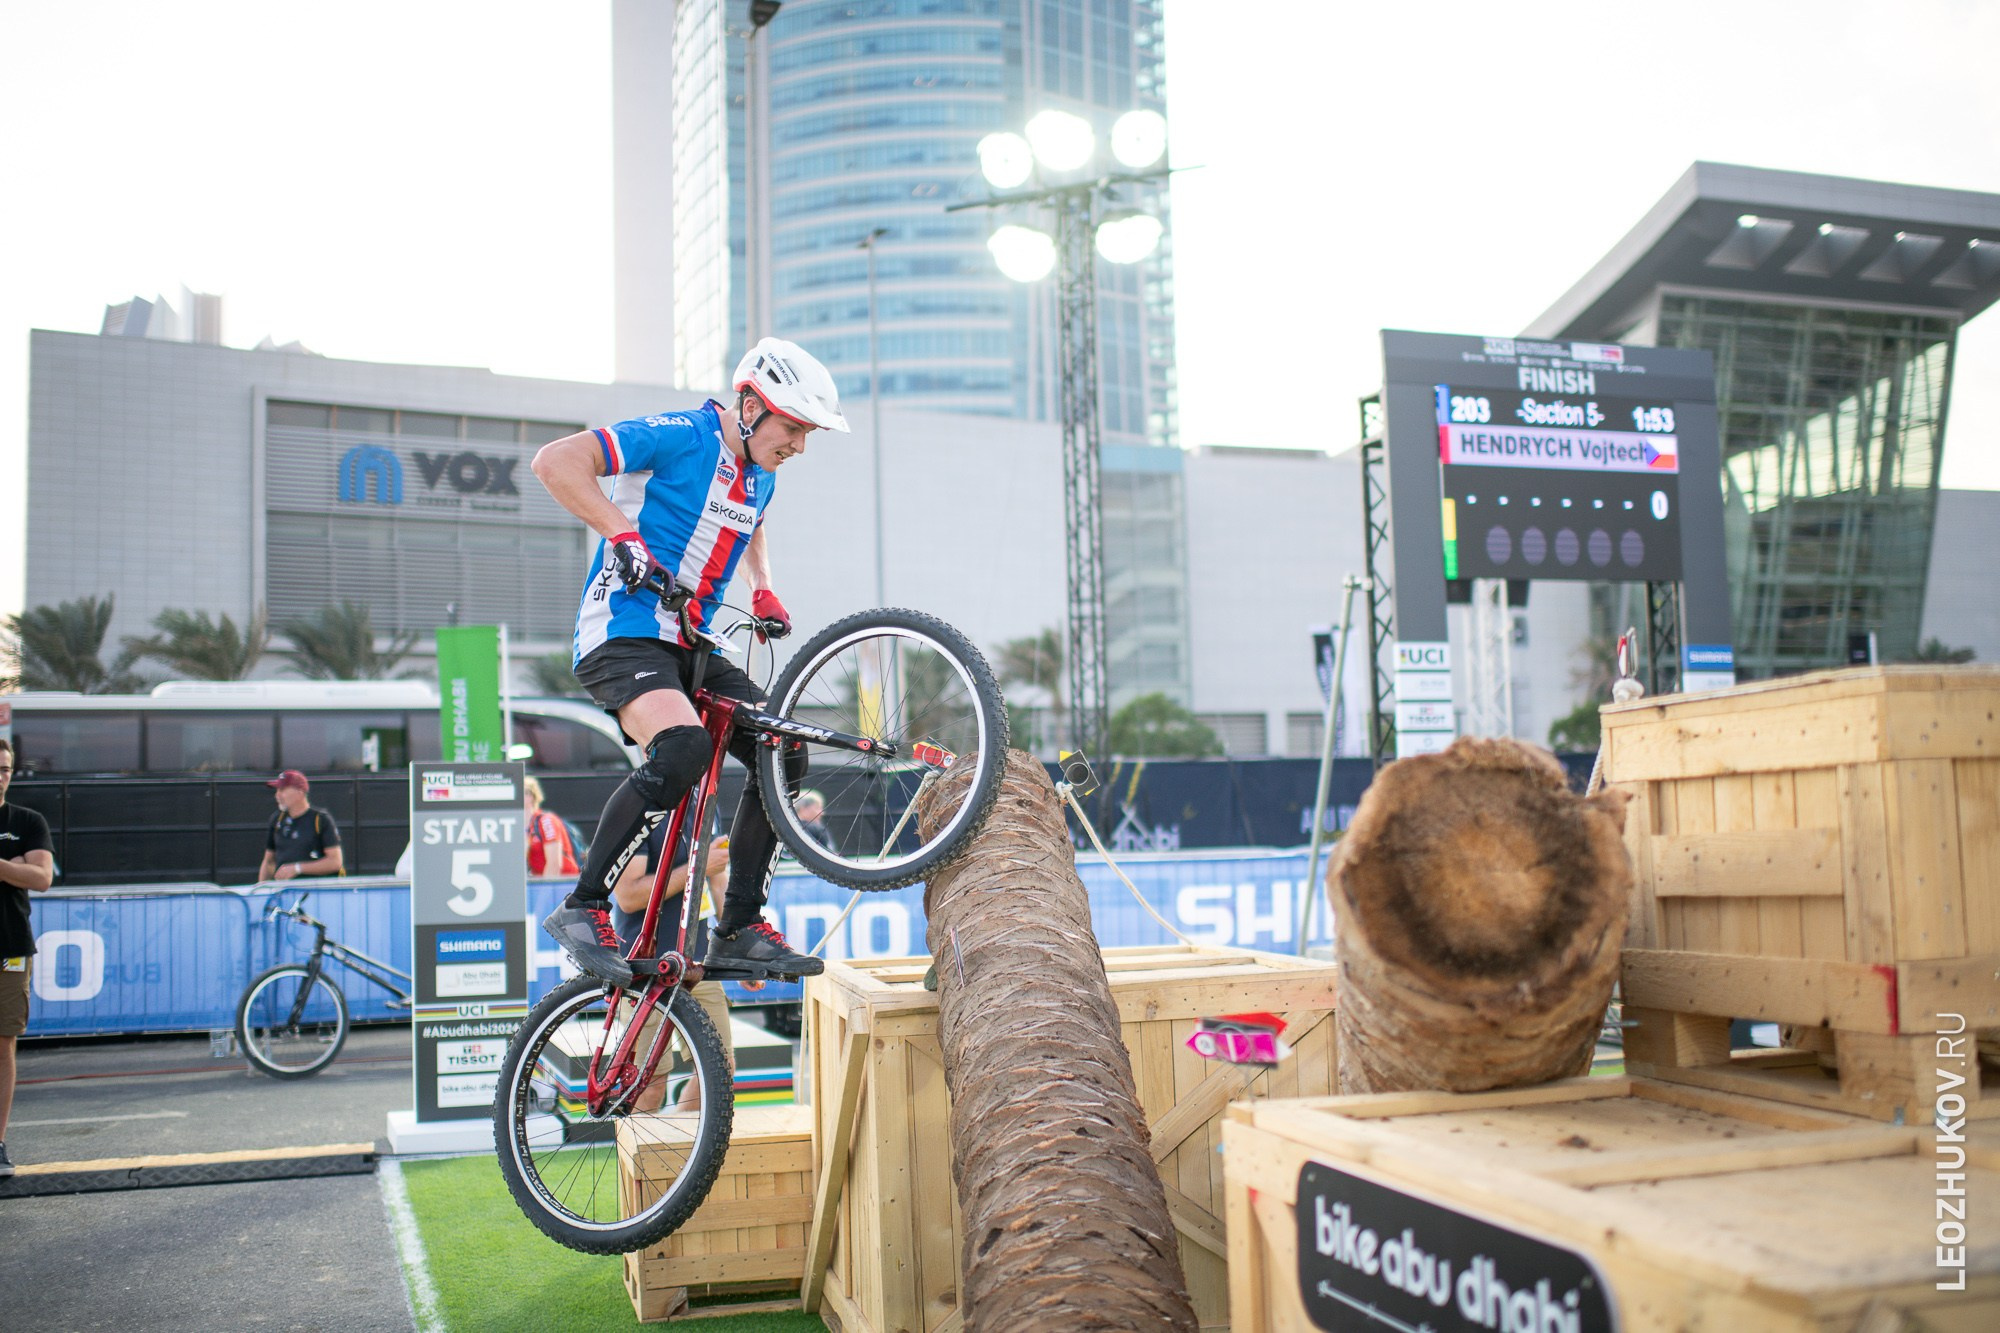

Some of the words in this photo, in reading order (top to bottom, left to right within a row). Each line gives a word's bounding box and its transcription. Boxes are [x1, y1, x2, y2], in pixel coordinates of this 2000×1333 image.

[1518, 367, 1596, 395] FINISH
[1451, 396, 1491, 423] 203
[1632, 406, 1675, 433] 1:53
[1461, 433, 1572, 457] HENDRYCH
[412, 451, 520, 496] VOX
[717, 466, 735, 480] czech
[1651, 490, 1668, 520] 0
[1408, 649, 1444, 664] UCI
[428, 775, 451, 785] UCI
[423, 818, 516, 845] START
[604, 825, 650, 889] CLEAN
[446, 850, 494, 917] 5
[440, 939, 502, 953] SHIMANO
[463, 972, 478, 980] Abu
[479, 970, 501, 979] Dhabi
[458, 1005, 485, 1017] UCI
[422, 1022, 520, 1039] #Abudhabi2024
[447, 1054, 498, 1065] TISSOT
[1315, 1195, 1379, 1277] bike
[1381, 1228, 1451, 1308] abu
[1456, 1254, 1581, 1333] dhabi
